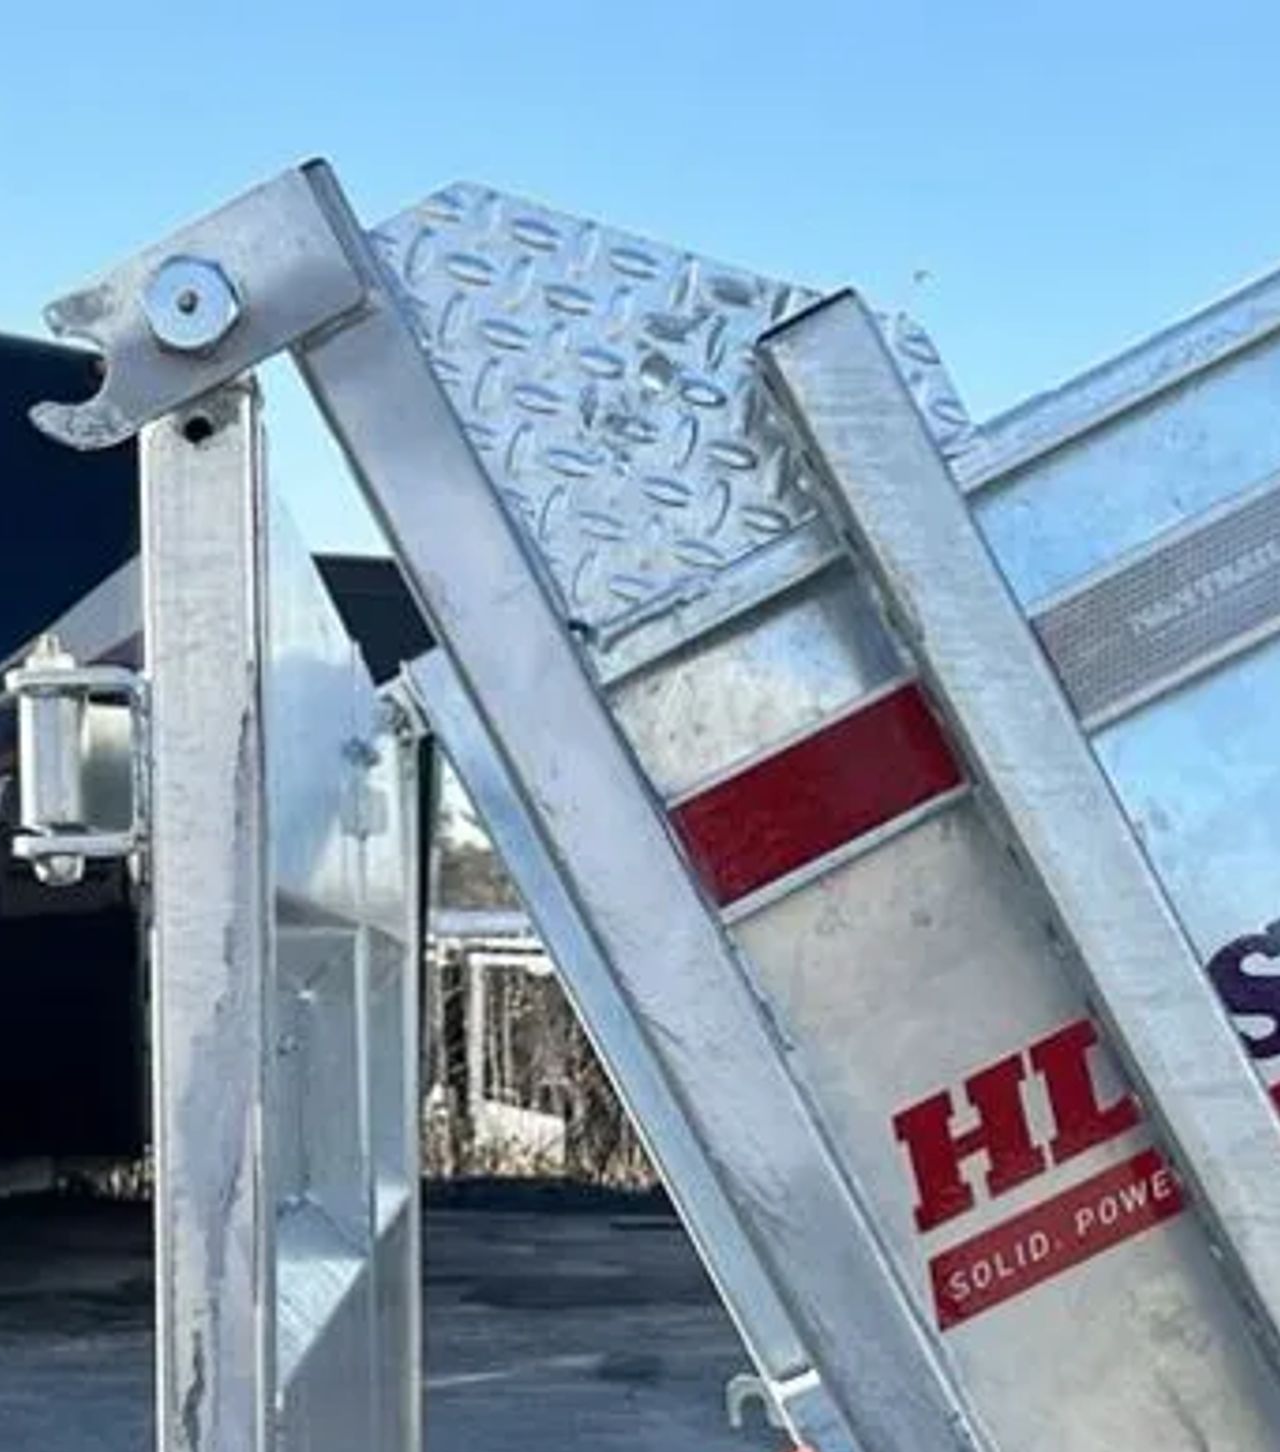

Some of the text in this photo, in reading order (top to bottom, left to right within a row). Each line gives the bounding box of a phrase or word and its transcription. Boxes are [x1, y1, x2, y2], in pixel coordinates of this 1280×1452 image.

[892, 1019, 1140, 1232] HL
[947, 1232, 1060, 1301] SOLID.
[1073, 1168, 1181, 1235] POWE
